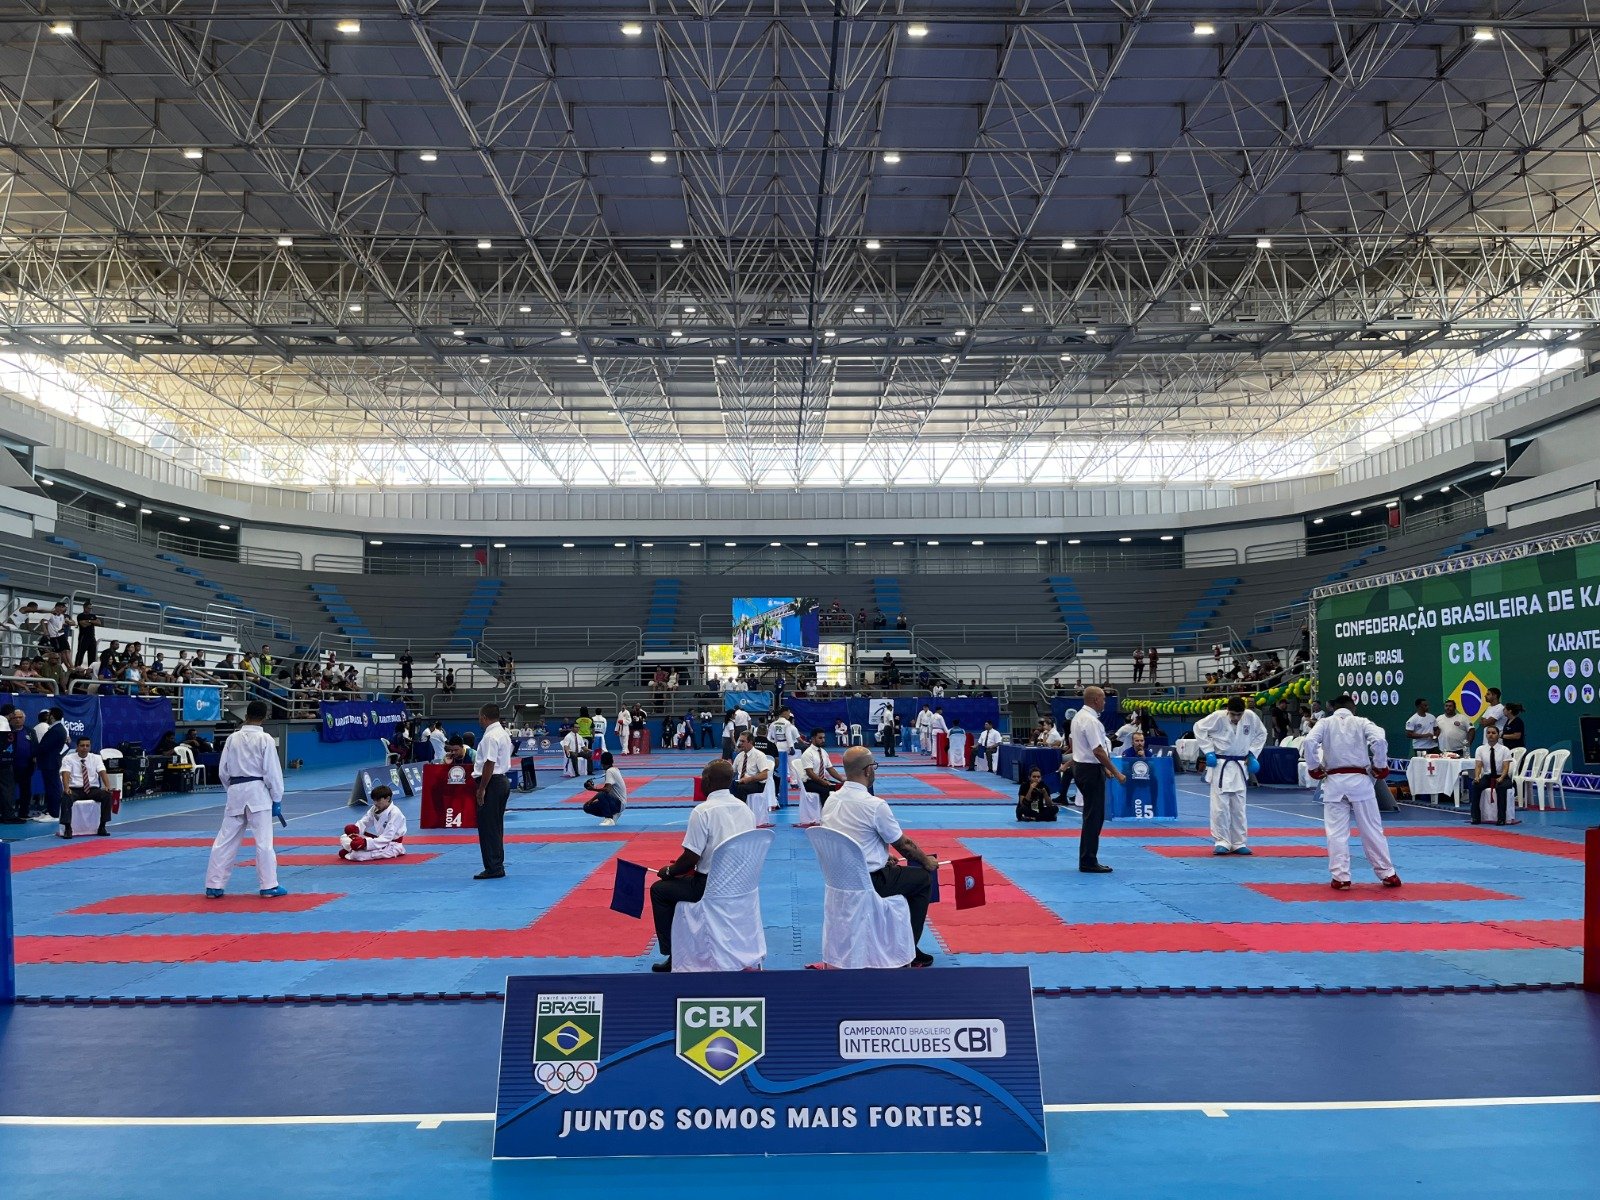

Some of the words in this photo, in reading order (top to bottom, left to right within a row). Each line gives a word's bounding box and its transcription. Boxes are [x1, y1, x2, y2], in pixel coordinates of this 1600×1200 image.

[1335, 606, 1437, 638] CONFEDERAÇÃO
[1441, 594, 1544, 626] BRASILEIRA
[1547, 588, 1575, 612] DE
[1337, 652, 1367, 667] KARATE
[1375, 648, 1404, 665] BRASIL
[1448, 639, 1492, 664] CBK
[445, 808, 454, 828] KOTO
[1135, 799, 1143, 819] KOTO
[1144, 804, 1154, 819] 5
[452, 812, 462, 828] 4
[539, 1001, 601, 1014] BRASIL
[684, 1006, 758, 1028] CBK
[844, 1026, 907, 1036] CAMPEONATO
[909, 1027, 951, 1035] BRASILEIRO
[845, 1038, 951, 1053] INTERCLUBES
[558, 1109, 665, 1138] JUNTOS
[676, 1107, 776, 1130] SOMOS
[787, 1106, 858, 1128] MAIS
[869, 1105, 983, 1128] FORTES!
